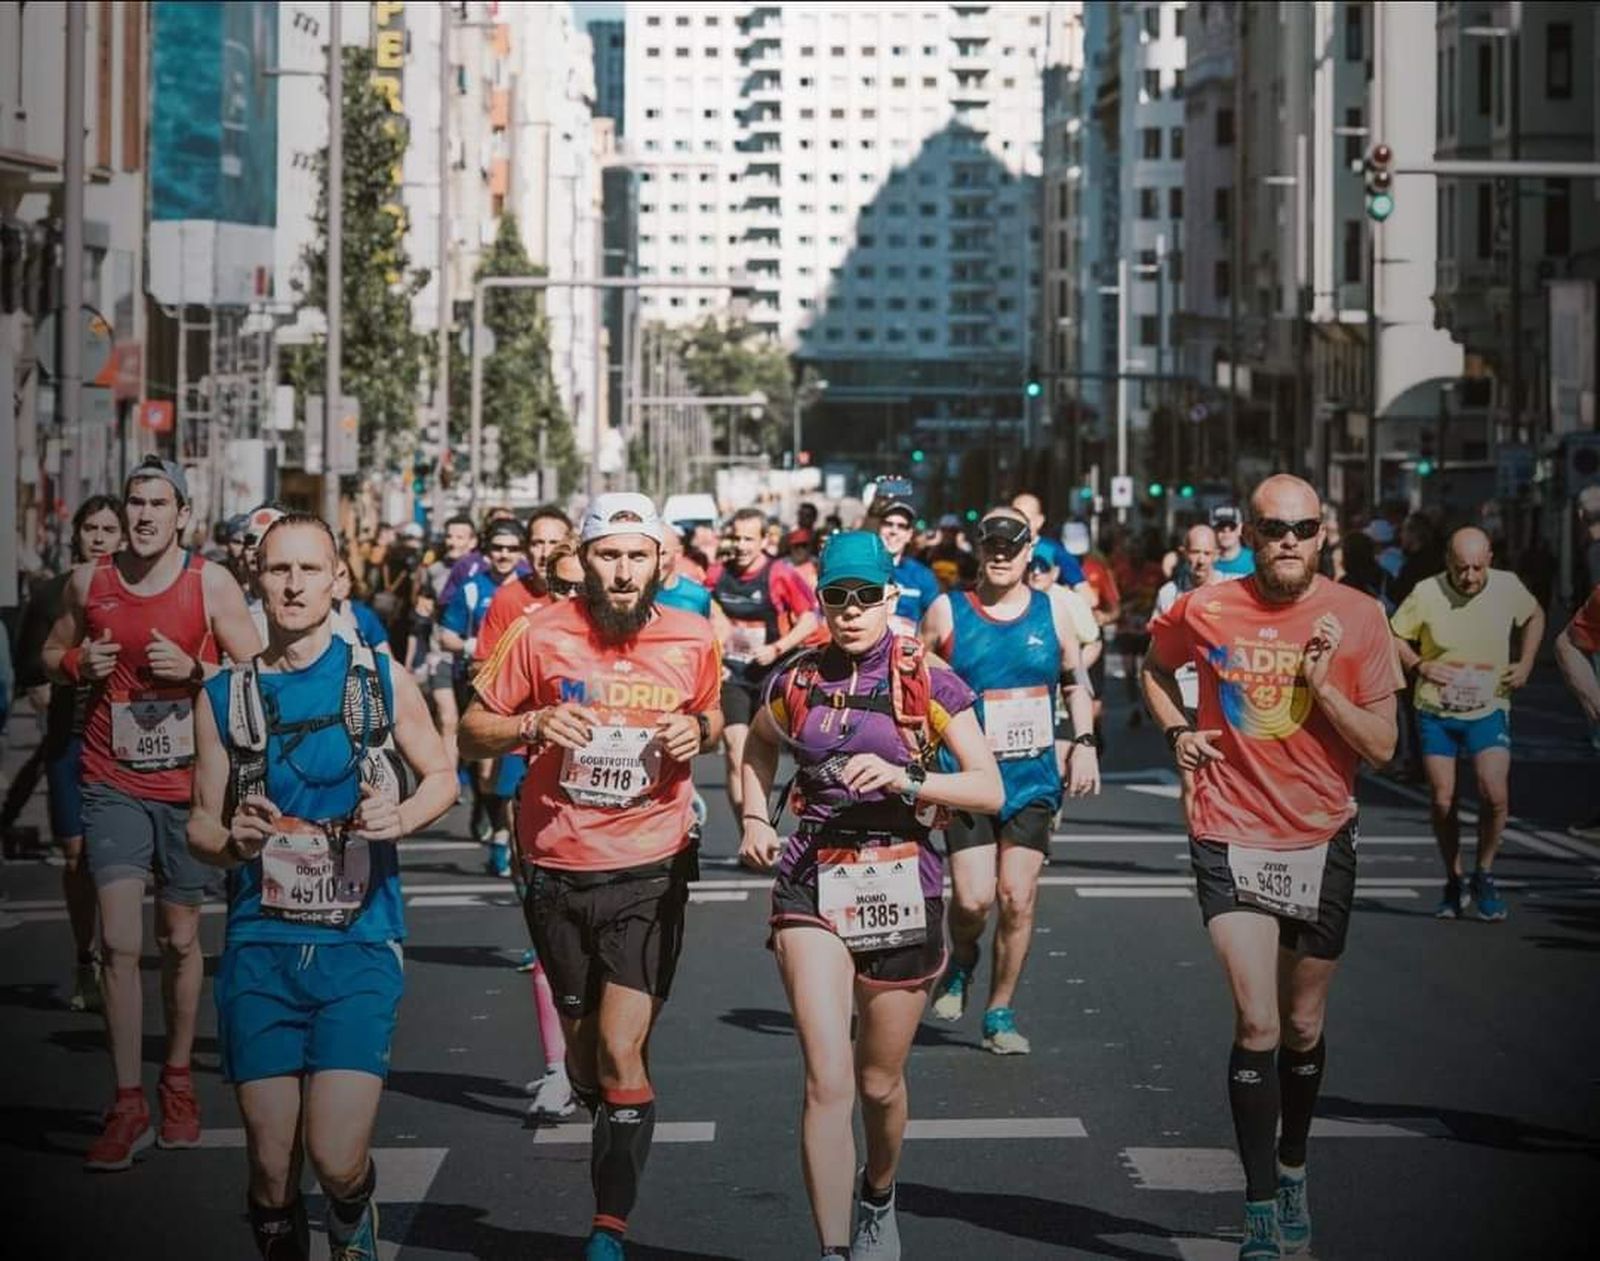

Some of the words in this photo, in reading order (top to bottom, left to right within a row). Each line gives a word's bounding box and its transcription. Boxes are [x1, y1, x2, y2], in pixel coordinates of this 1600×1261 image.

[560, 678, 681, 713] MADRID
[137, 735, 171, 756] 4915
[590, 767, 632, 791] 5118
[291, 878, 336, 904] 4910
[1257, 872, 1292, 898] 9438
[855, 893, 887, 905] MOMO
